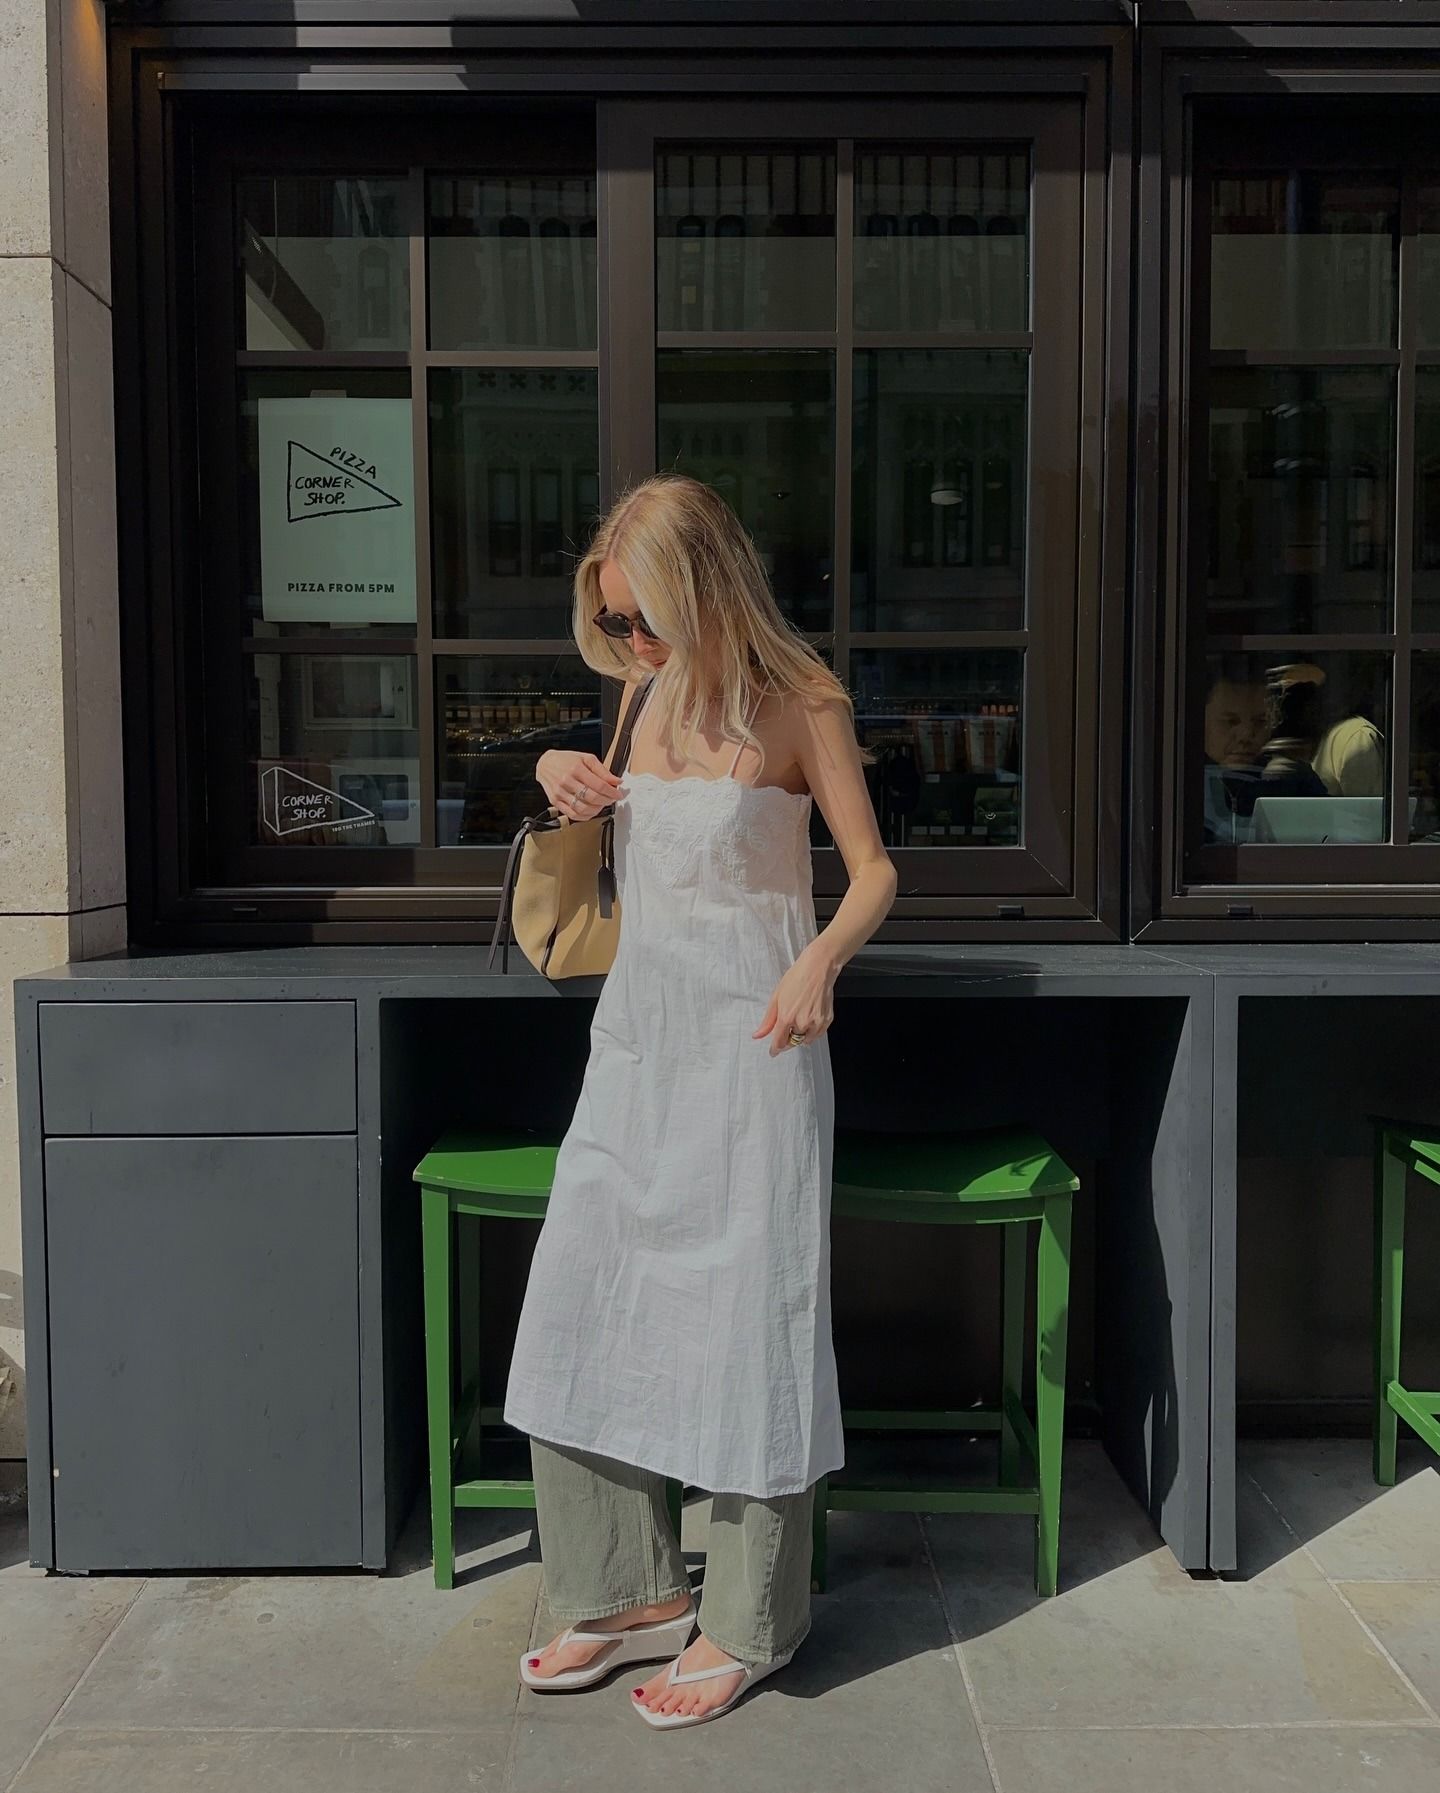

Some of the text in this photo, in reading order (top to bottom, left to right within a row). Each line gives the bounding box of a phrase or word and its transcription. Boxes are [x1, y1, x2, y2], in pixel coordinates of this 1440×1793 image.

[329, 446, 377, 479] PIZZA
[295, 476, 355, 489] CORNER
[304, 492, 346, 506] SHOP.
[287, 583, 395, 593] PIZZA FROM 5PM
[282, 793, 334, 807] CORNER
[290, 807, 326, 821] SHOP.
